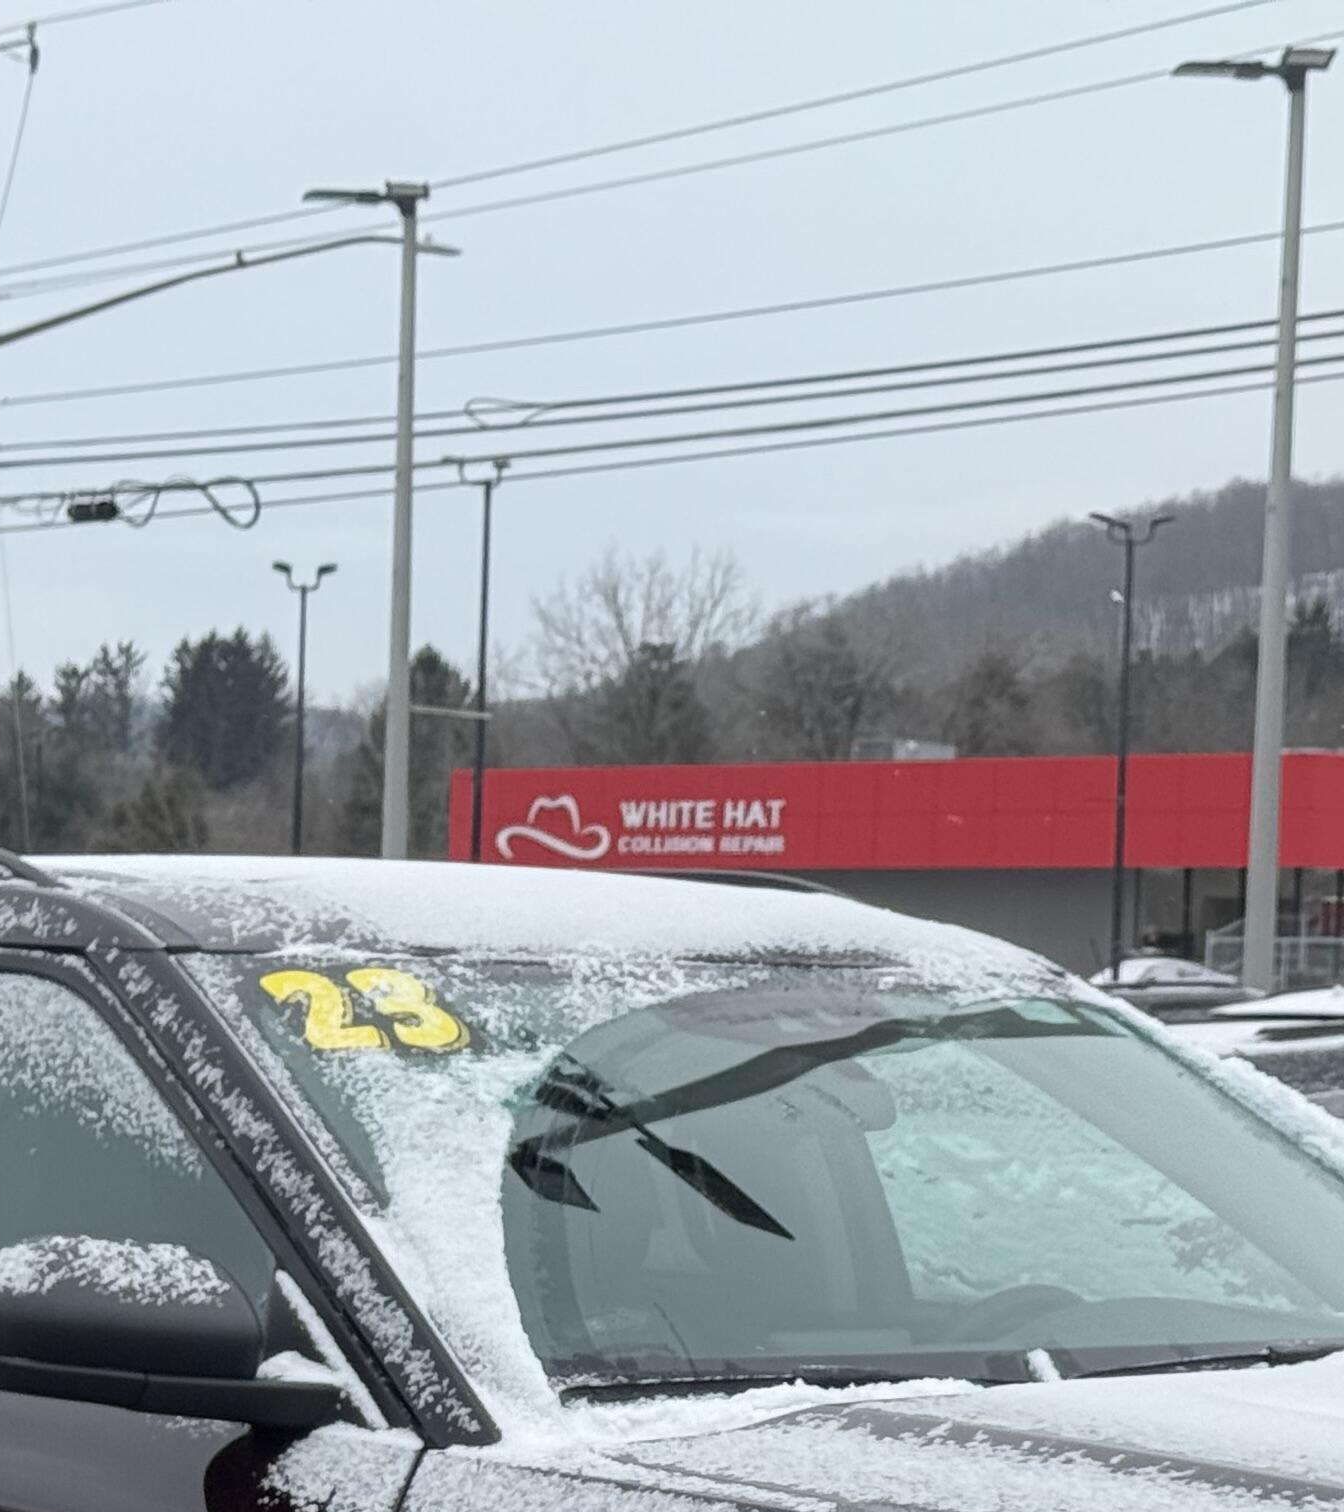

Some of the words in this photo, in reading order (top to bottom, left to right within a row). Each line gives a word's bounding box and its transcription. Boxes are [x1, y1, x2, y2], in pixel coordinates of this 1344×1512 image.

[619, 800, 716, 828] WHITE
[722, 798, 786, 828] HAT
[260, 964, 470, 1050] 23
